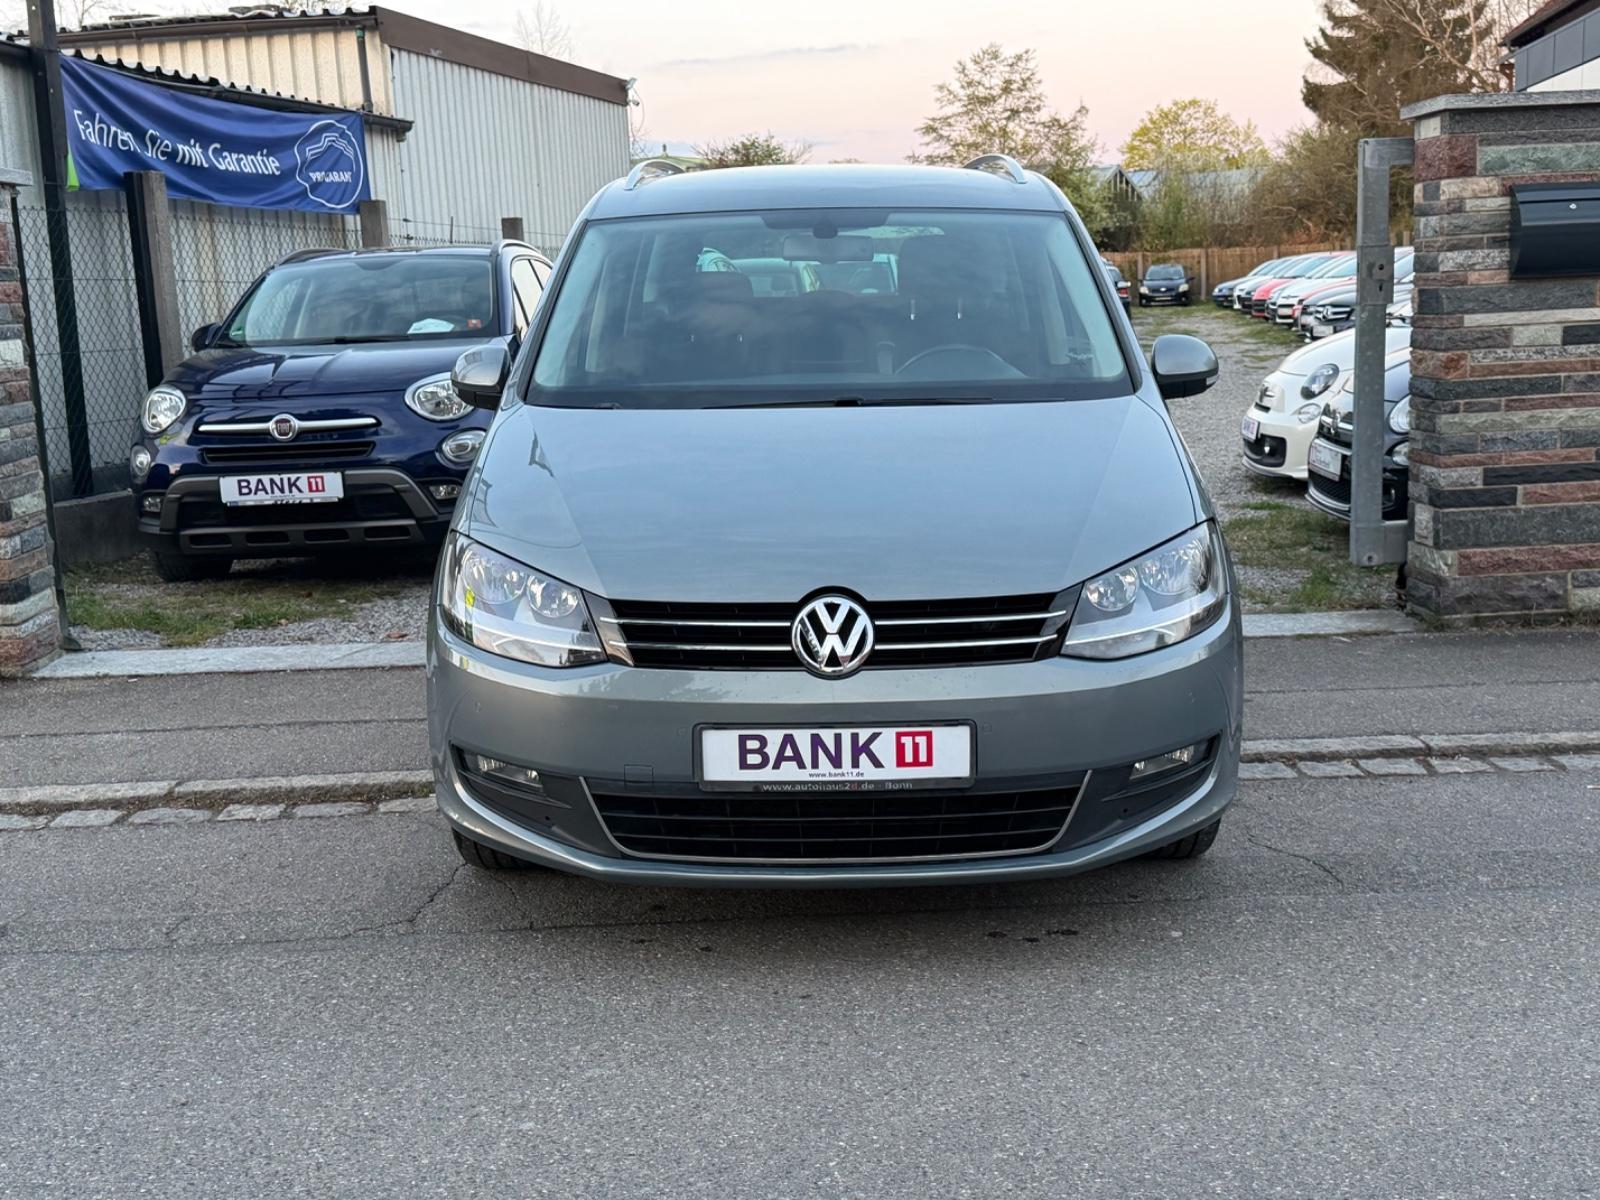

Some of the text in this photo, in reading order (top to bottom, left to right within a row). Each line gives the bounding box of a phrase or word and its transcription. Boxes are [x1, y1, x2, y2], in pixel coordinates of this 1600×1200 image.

[73, 108, 281, 176] Fahren Sie mit Garantie
[237, 476, 325, 496] BANK 11
[797, 598, 867, 670] VW
[738, 731, 930, 771] BANK 11
